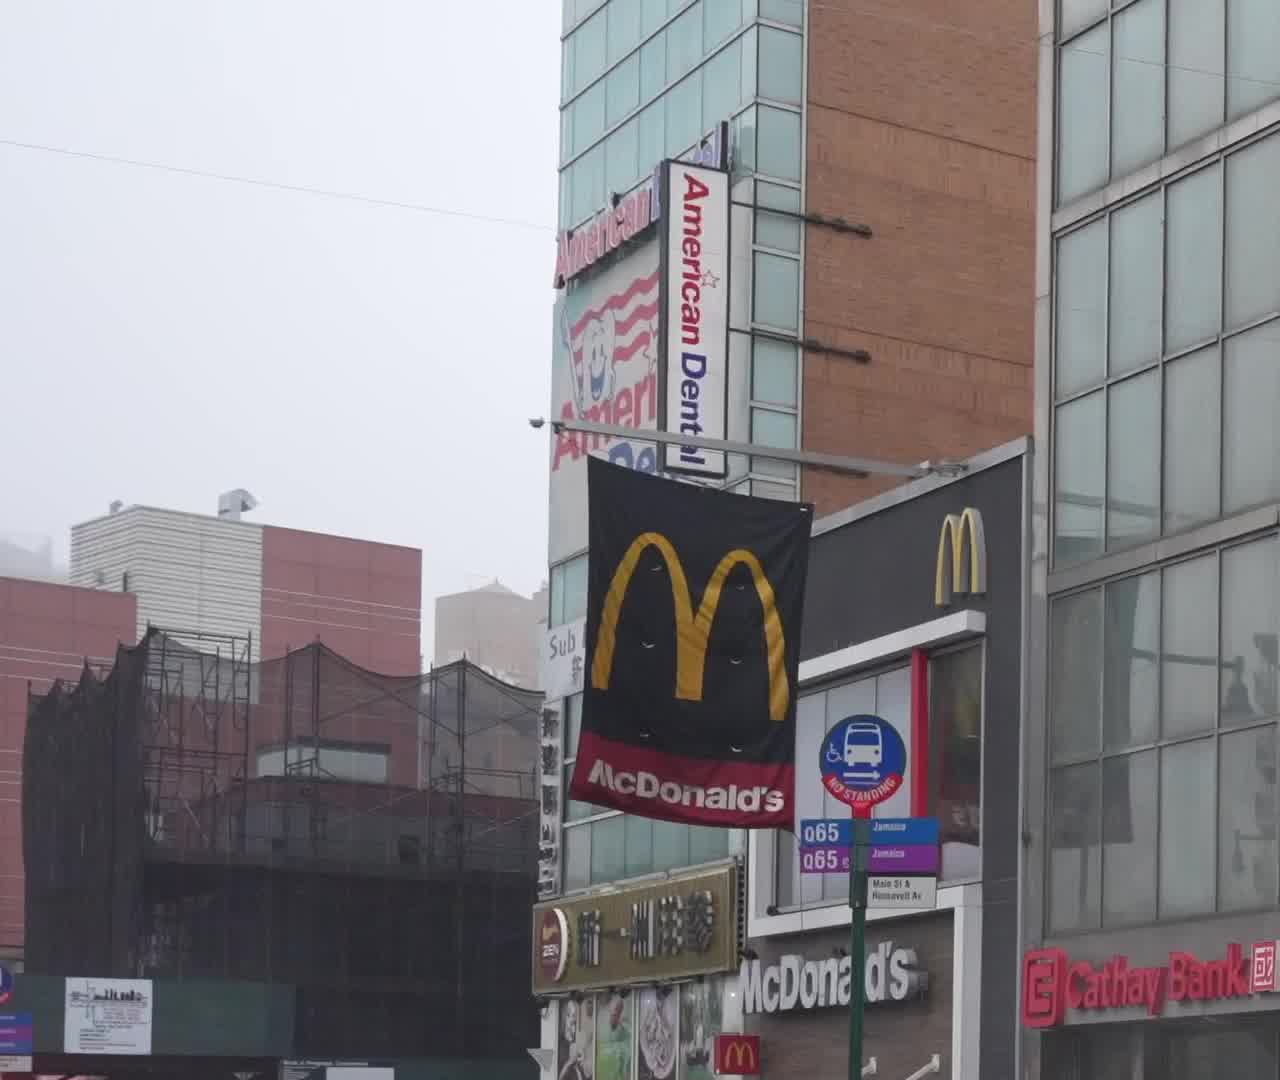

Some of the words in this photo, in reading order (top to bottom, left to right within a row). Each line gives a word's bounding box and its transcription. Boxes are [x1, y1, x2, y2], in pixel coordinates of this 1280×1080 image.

[682, 172, 709, 346] American
[680, 353, 707, 465] Dentl
[588, 758, 786, 814] McDonald's
[843, 776, 897, 802] STANDING
[803, 848, 839, 871] Q65
[804, 822, 840, 843] Q65
[740, 940, 920, 1015] McDonad's
[1064, 952, 1163, 1016] Cathay
[1167, 942, 1251, 1002] Bank
